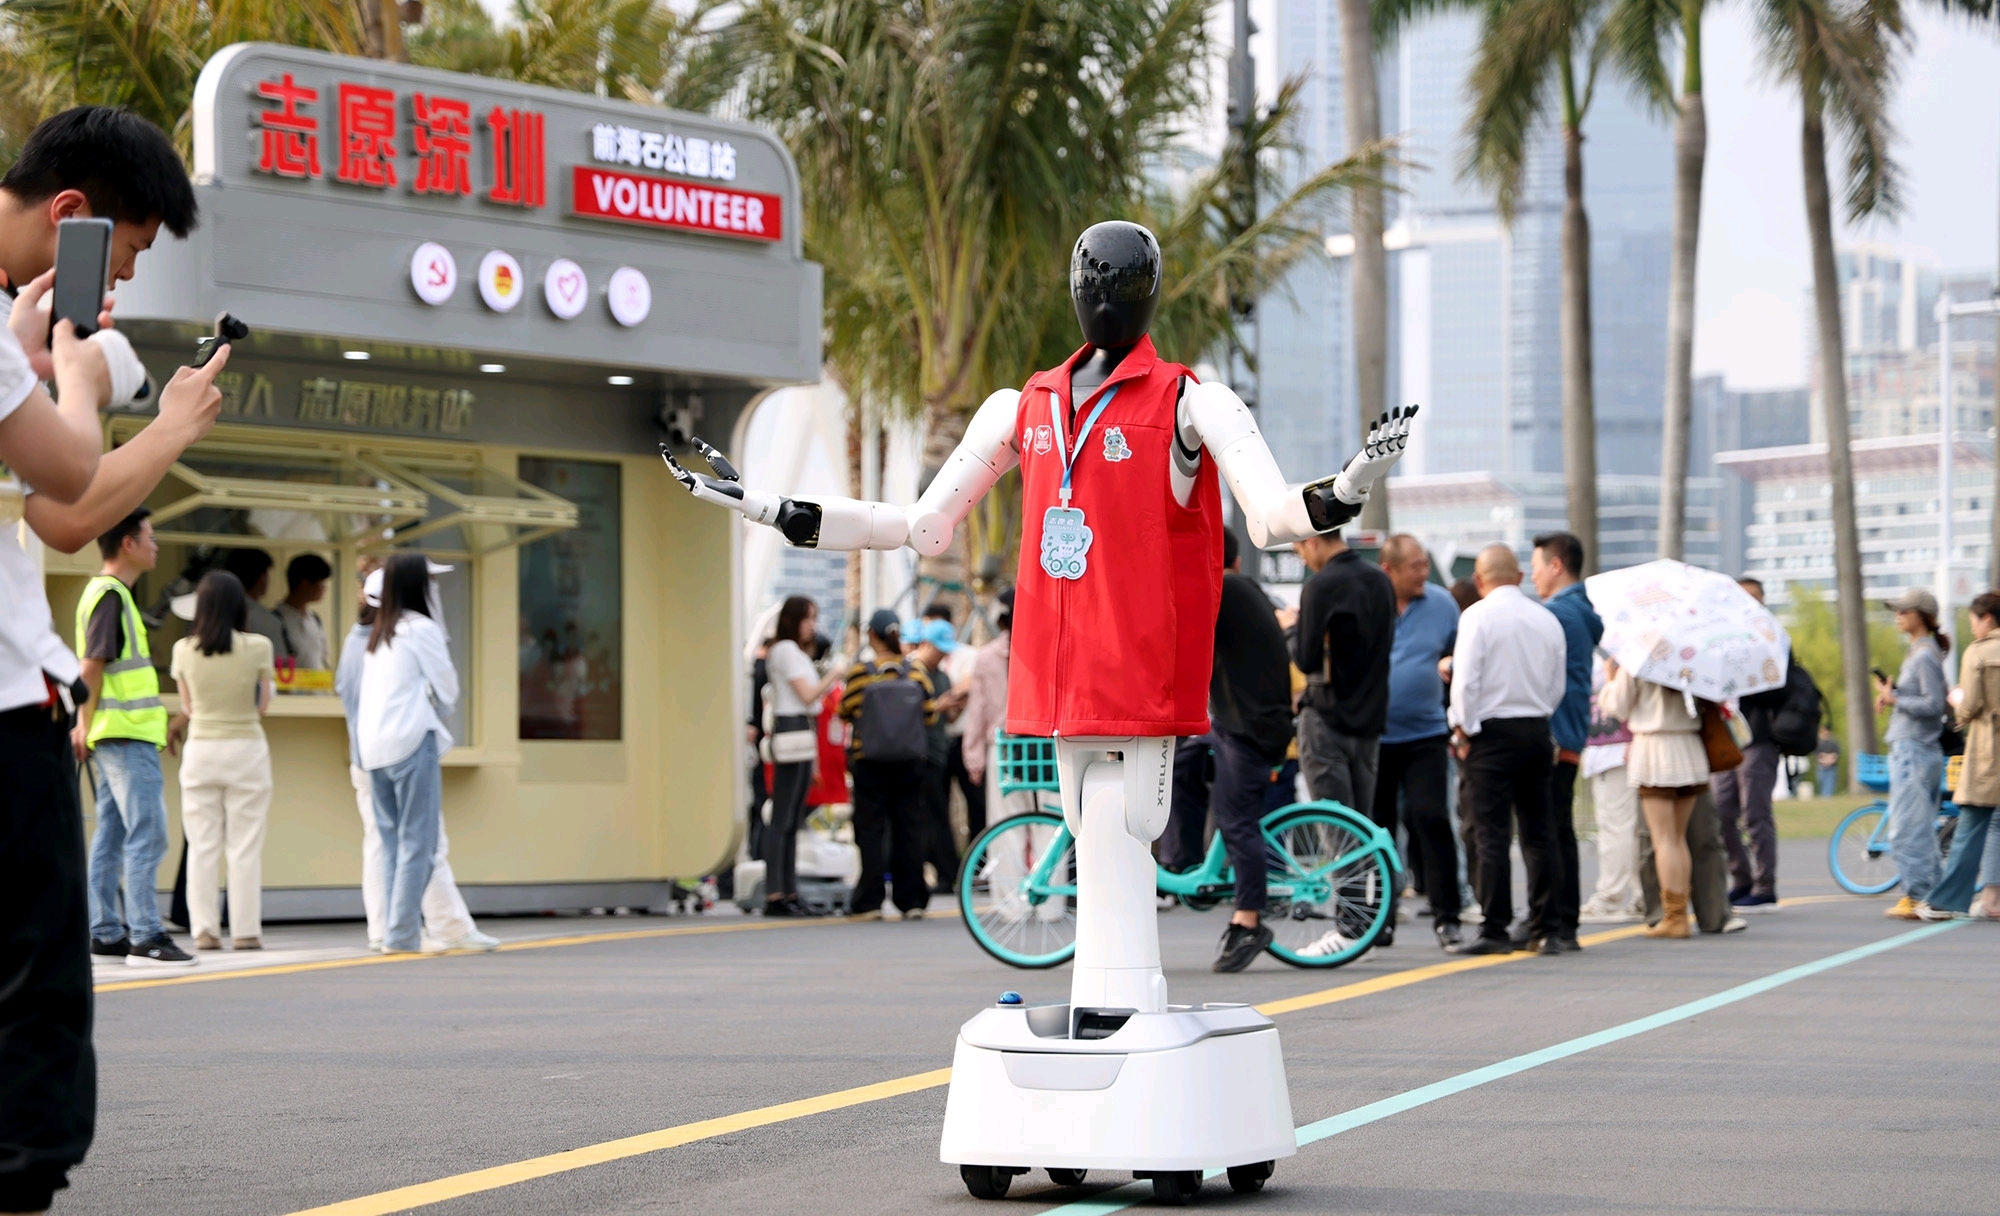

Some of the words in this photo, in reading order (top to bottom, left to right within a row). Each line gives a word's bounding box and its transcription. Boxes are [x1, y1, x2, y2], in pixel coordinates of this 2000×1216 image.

[257, 72, 546, 208] 志愿深圳
[592, 174, 765, 233] VOLUNTEER
[1157, 738, 1168, 807] XTELLAR
